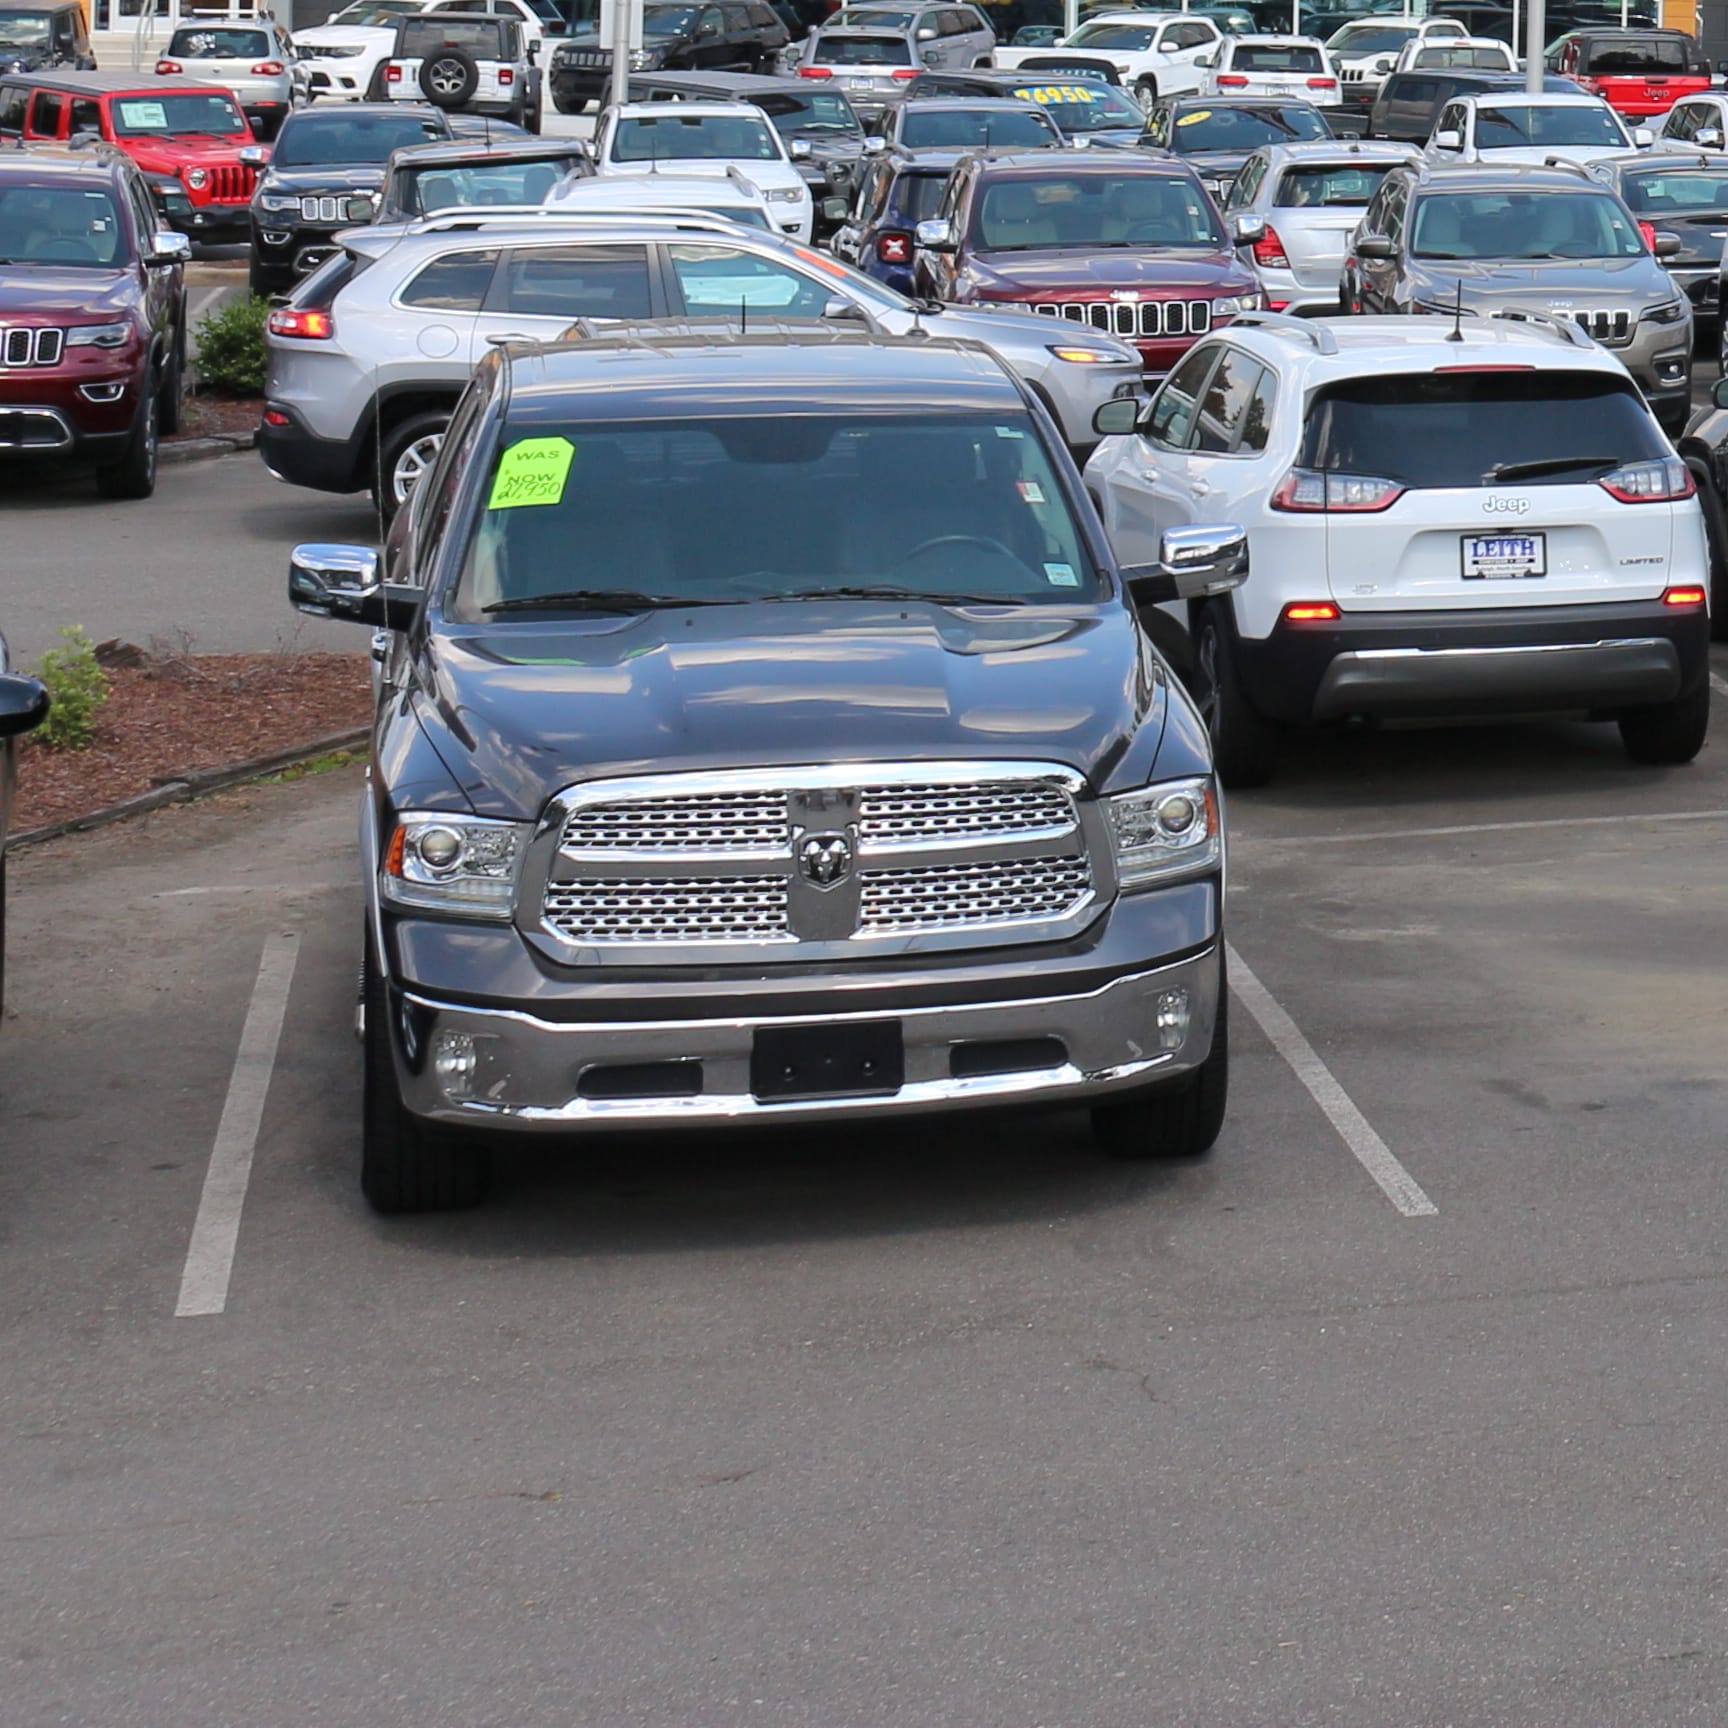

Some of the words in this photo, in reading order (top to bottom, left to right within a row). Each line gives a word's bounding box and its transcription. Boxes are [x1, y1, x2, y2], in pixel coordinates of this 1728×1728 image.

[1643, 87, 1670, 99] Jeep
[516, 450, 560, 462] WAS
[508, 473, 556, 484] NOW
[1483, 495, 1530, 514] Jeep
[1472, 540, 1536, 558] LEITH
[1619, 556, 1664, 566] LIMITED
